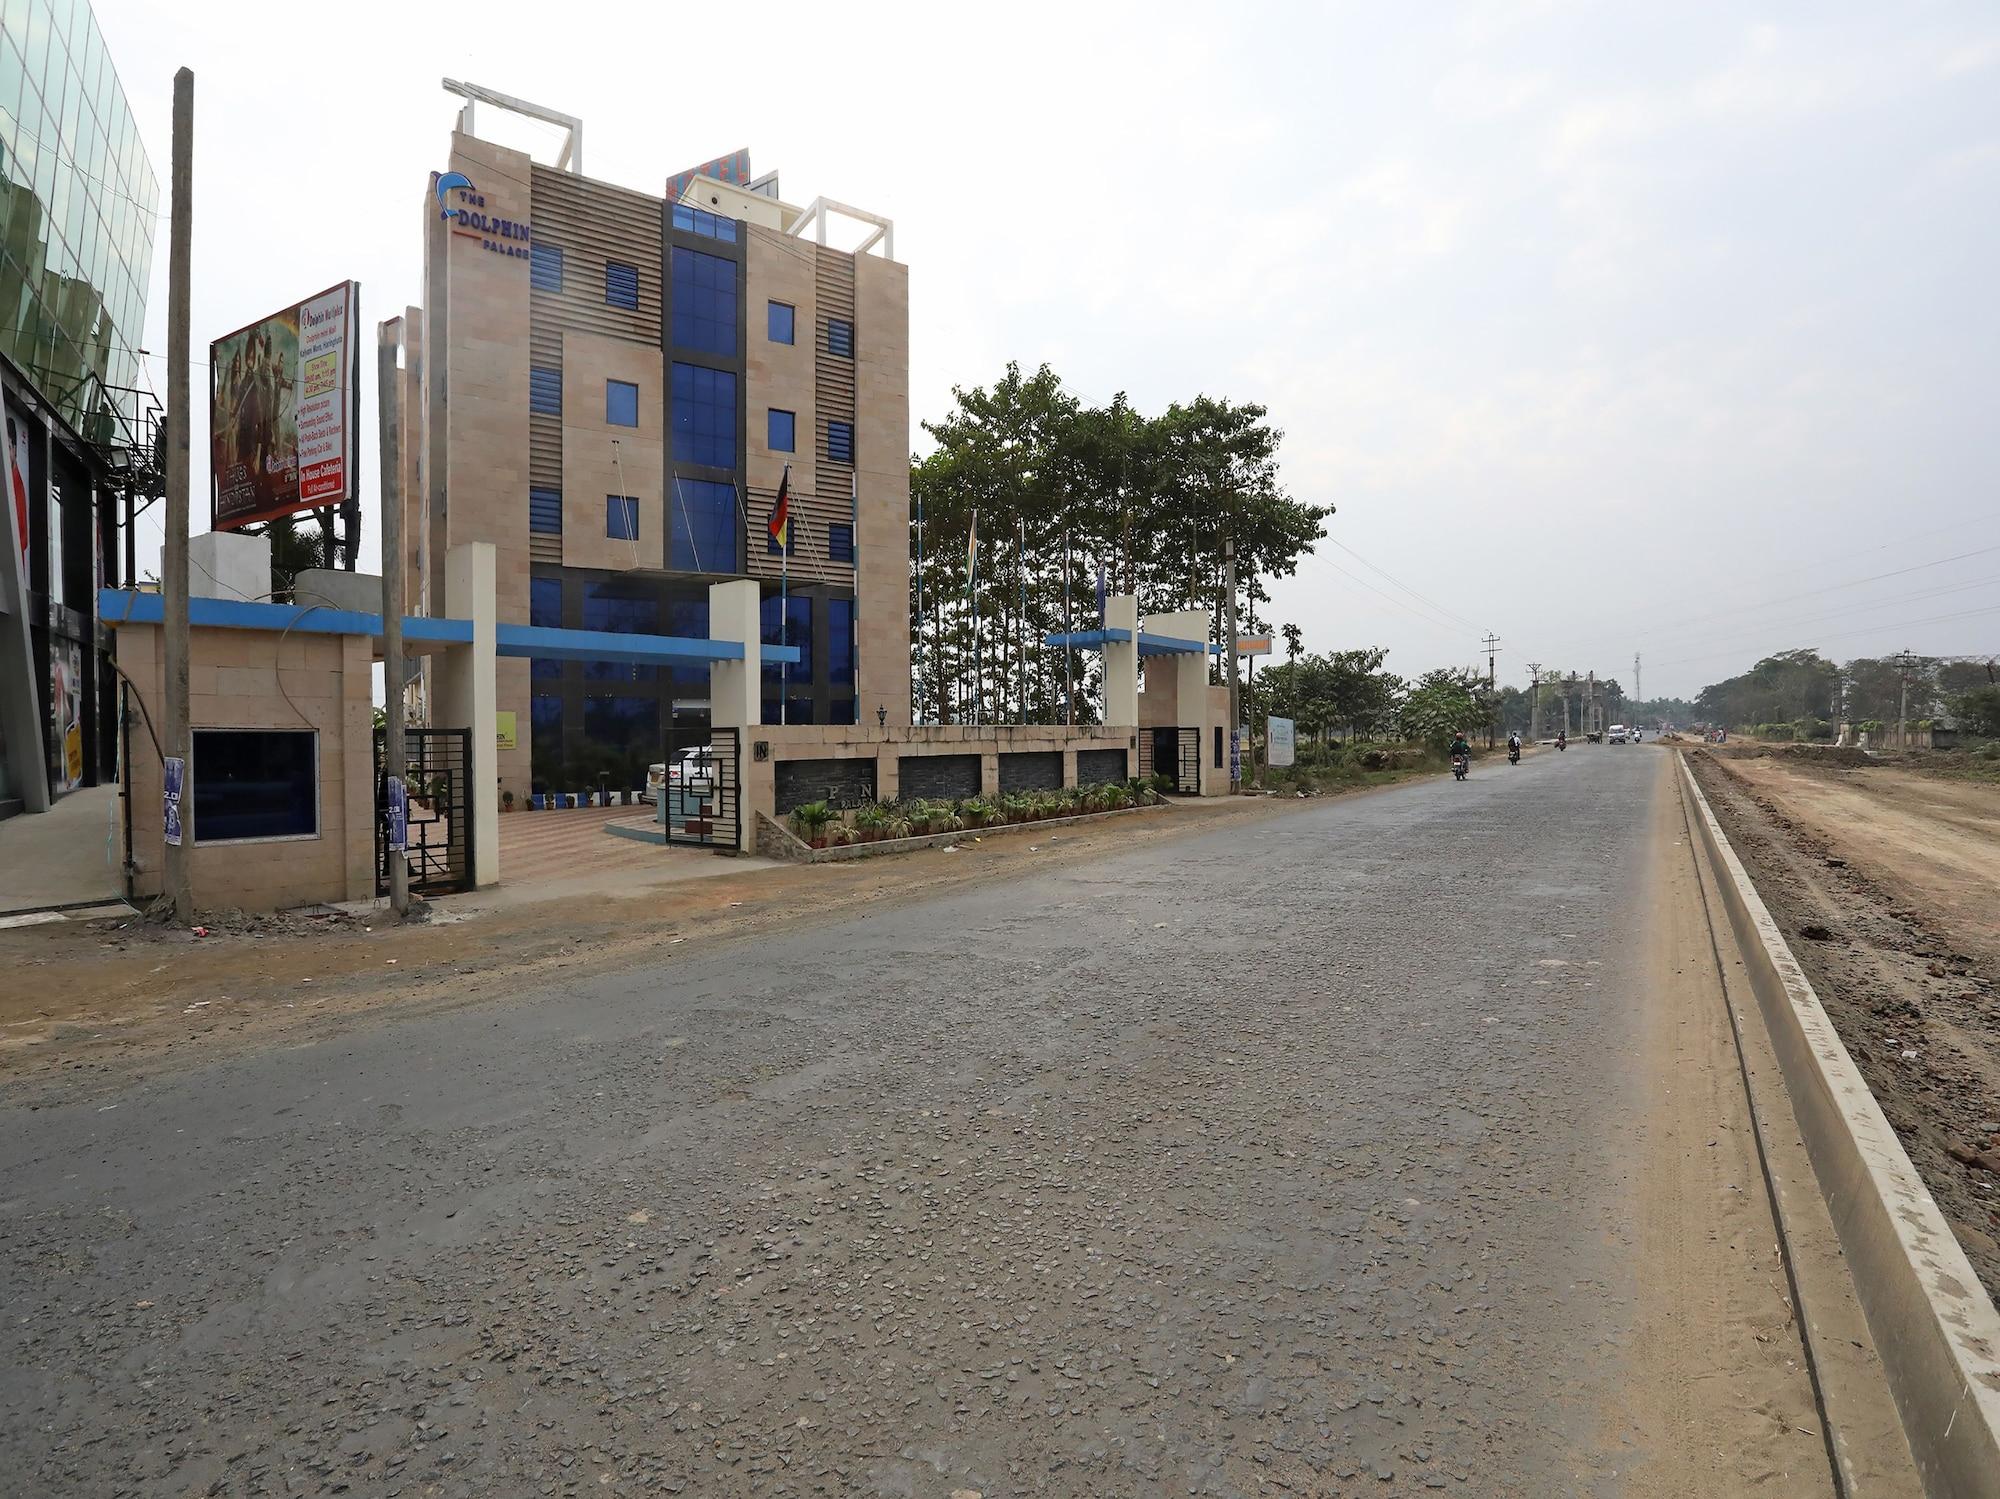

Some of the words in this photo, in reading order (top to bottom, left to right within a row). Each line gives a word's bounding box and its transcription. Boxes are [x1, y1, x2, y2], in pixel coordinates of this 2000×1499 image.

[460, 191, 484, 207] THE
[458, 209, 530, 241] DOLPHIN
[483, 240, 529, 260] PALACE
[306, 467, 320, 480] House
[320, 460, 342, 477] Cafeteria
